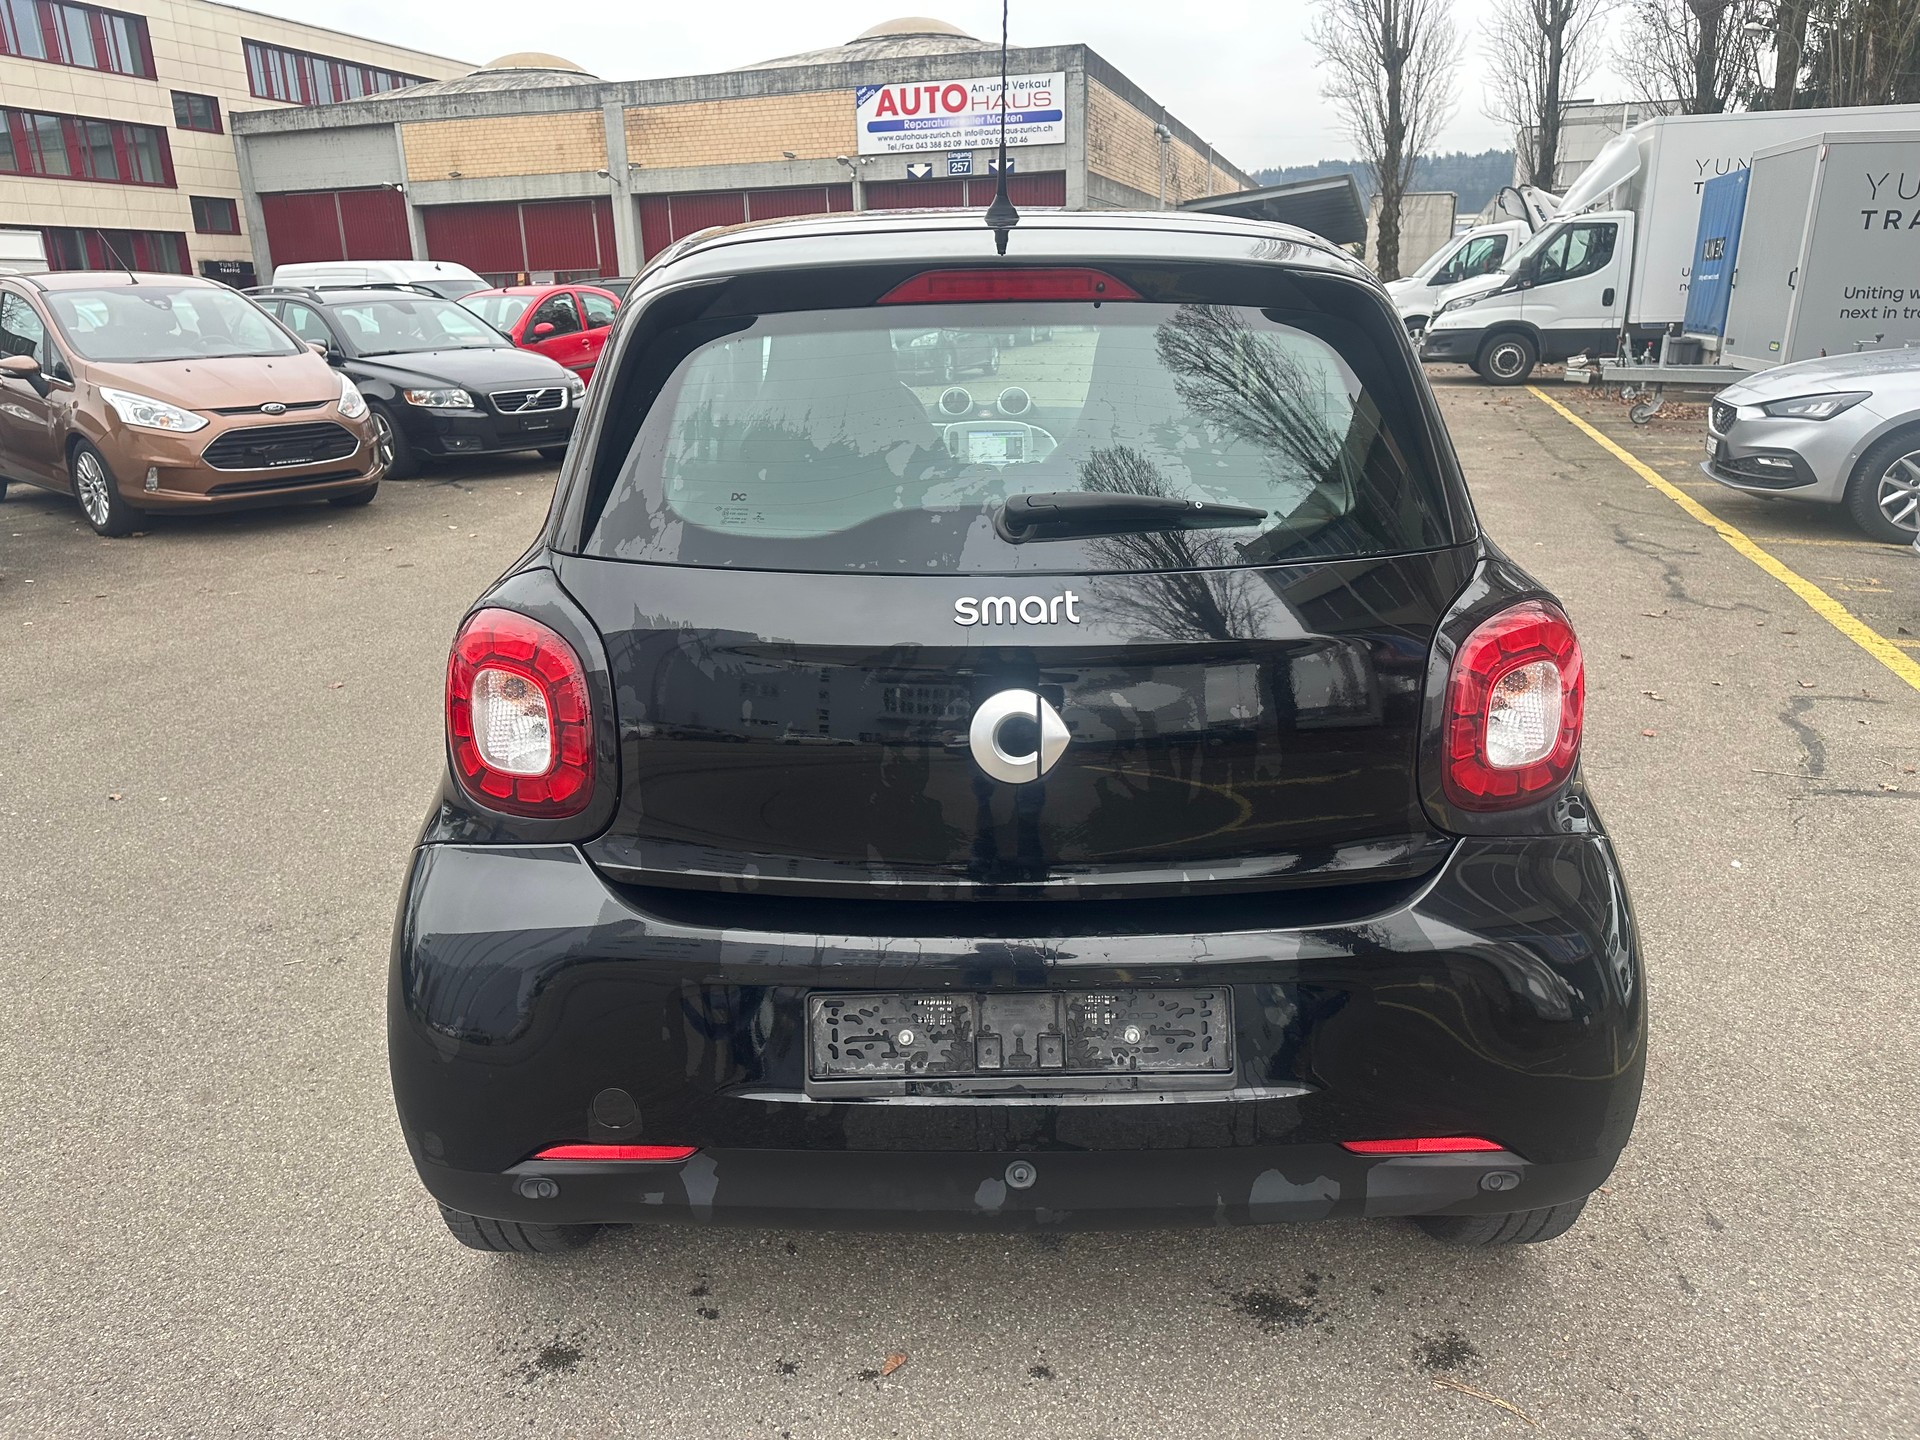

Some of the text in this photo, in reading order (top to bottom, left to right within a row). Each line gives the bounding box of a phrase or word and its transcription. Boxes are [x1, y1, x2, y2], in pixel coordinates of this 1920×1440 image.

[971, 84, 984, 92] An
[1012, 78, 1051, 90] Verkauf
[875, 83, 968, 118] AUTO
[971, 90, 1052, 111] HAUS
[986, 113, 1023, 124] Maken
[877, 124, 1053, 142] www.autohaus-zurich.ch info@autoaus-zurich.ch
[929, 141, 942, 149] 388
[943, 140, 952, 148] 82
[981, 138, 993, 146] 076
[1008, 136, 1018, 144] 00
[947, 151, 972, 159] Eingang
[951, 162, 969, 172] 257
[1844, 286, 1904, 303] Uniting
[1840, 307, 1878, 319] next
[1882, 305, 1897, 319] in
[953, 590, 1081, 626] smart
